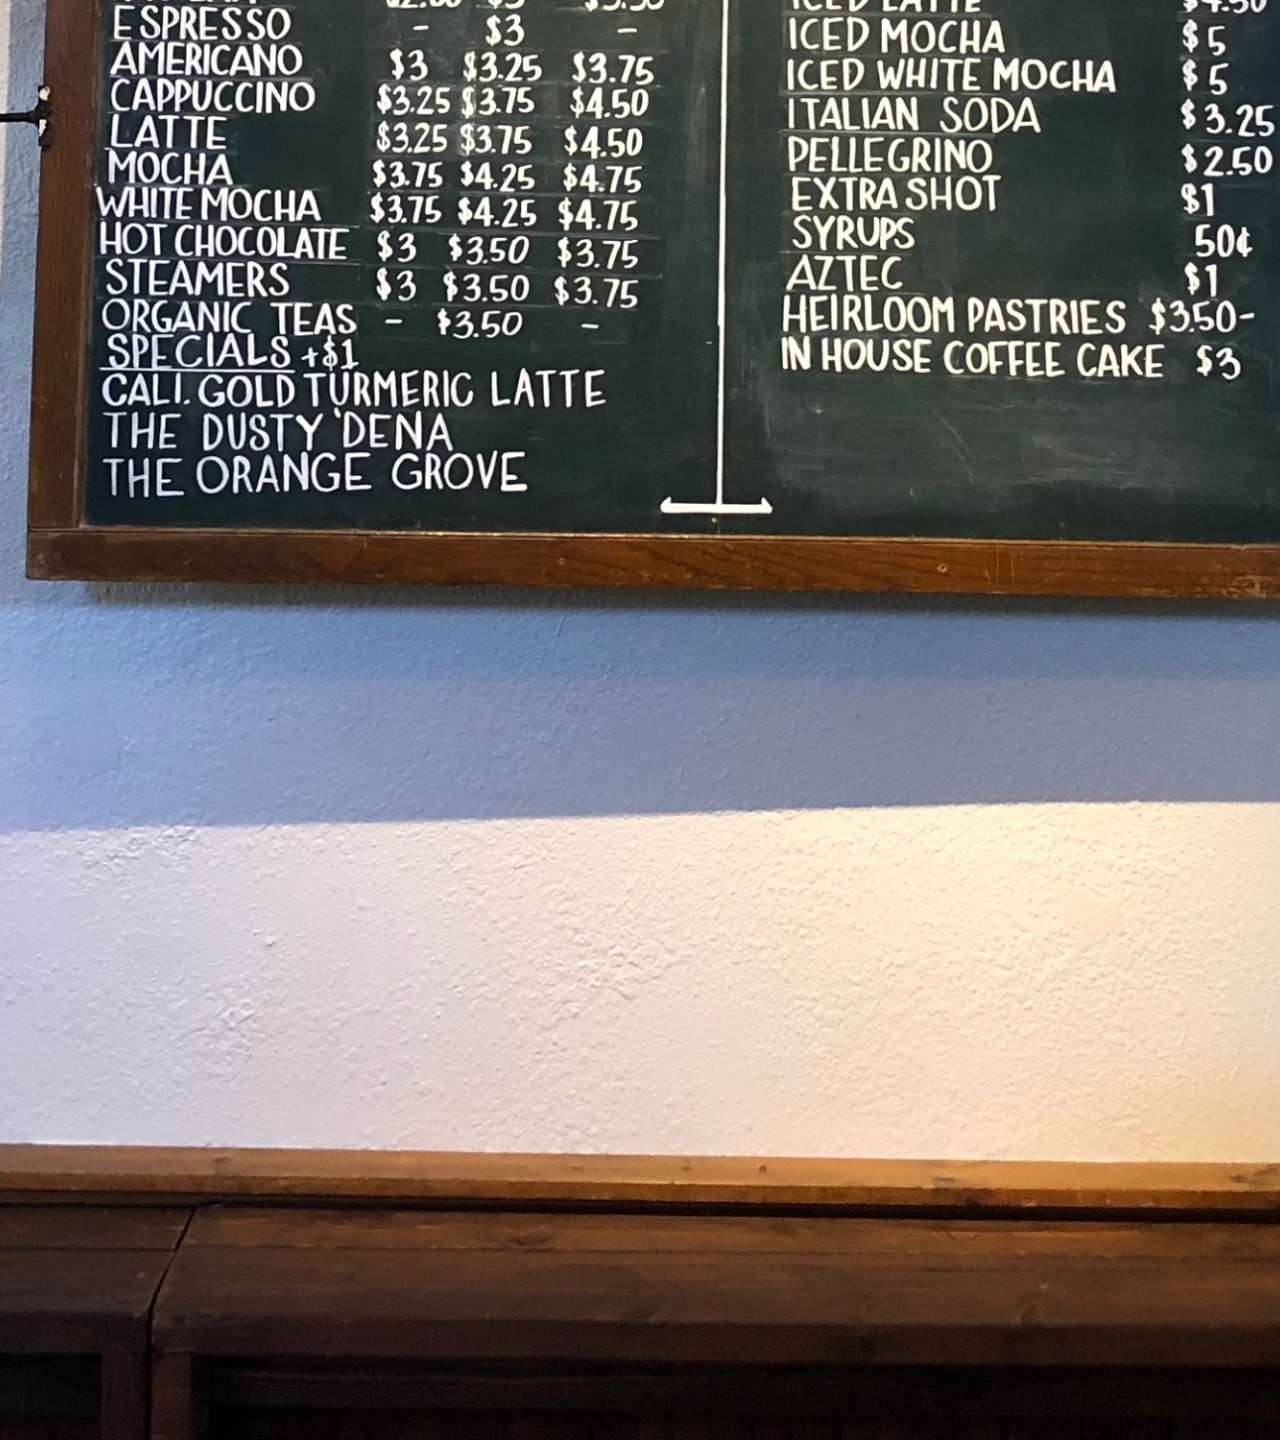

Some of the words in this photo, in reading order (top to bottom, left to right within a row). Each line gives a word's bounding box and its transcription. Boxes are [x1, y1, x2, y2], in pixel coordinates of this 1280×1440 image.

[113, 4, 292, 41] ESPRESSO
[485, 13, 525, 47] $3
[788, 15, 870, 52] ICED
[881, 17, 1006, 55] MOCHA
[109, 40, 303, 78] AMERICANO
[389, 47, 429, 82] $3
[462, 50, 543, 83] $3.25
[571, 50, 655, 86] $3.75
[787, 57, 865, 91] ICED
[876, 57, 982, 93] WHITE
[993, 57, 1117, 93] MOCHA
[110, 77, 316, 114] CAPPUCCINO
[376, 83, 451, 116] $3.25
[461, 86, 535, 119] $3.75
[569, 85, 650, 120] $4.50
[788, 96, 919, 131] ITALIAN
[939, 96, 1042, 134] SODA
[110, 113, 228, 150] LATTE
[376, 120, 448, 154] $3.25
[459, 122, 533, 156] $3.75
[564, 125, 643, 160] $4.50
[787, 135, 993, 174] PELLEGRINO
[104, 147, 234, 186] MOCHA
[372, 158, 443, 190] $3.75
[460, 160, 535, 193] $4.25
[563, 162, 643, 194] $4.75
[95, 186, 194, 220] WHITE
[201, 185, 322, 222] MOCHA
[369, 191, 442, 224] $3.75
[457, 196, 537, 228] $4.25
[558, 196, 639, 232] $4.75
[791, 176, 898, 212] EXTRA
[905, 174, 1002, 212] SHOT
[1180, 182, 1215, 217] $1
[99, 220, 168, 257] HOT
[174, 224, 350, 260] CHOCOLATE
[377, 229, 417, 263] $3
[448, 232, 530, 266] $3.50
[557, 236, 639, 270] $3.75
[792, 214, 915, 251] SYRUPS
[1194, 223, 1253, 258] 50¢
[105, 257, 290, 298] STEAMERS
[376, 266, 417, 302] $3
[442, 270, 530, 302] $3.50
[554, 275, 639, 309] $3.75
[785, 253, 903, 292] AZTEC
[1184, 261, 1218, 298] $1
[101, 297, 252, 334] ORGANIC
[269, 301, 358, 337] TEAS
[437, 307, 523, 340] $3.50
[782, 293, 955, 334] HEIRLOOM
[967, 296, 1126, 336] PASTRIES
[106, 332, 291, 369] SPECIALS
[781, 335, 812, 371] IN
[821, 337, 932, 374] HOUSE
[943, 340, 1066, 378] COFFEE
[1076, 342, 1165, 378] CAKE
[1196, 344, 1241, 380] $3
[101, 372, 191, 407] CALI.
[197, 373, 296, 408] GOLD
[302, 369, 474, 408] TURMERIC
[491, 367, 607, 408] LATTE
[102, 411, 182, 450] THE
[202, 411, 324, 453] DUSTY
[102, 457, 185, 498] THE
[196, 451, 373, 494] ORANGE
[391, 449, 528, 492] GROVE
